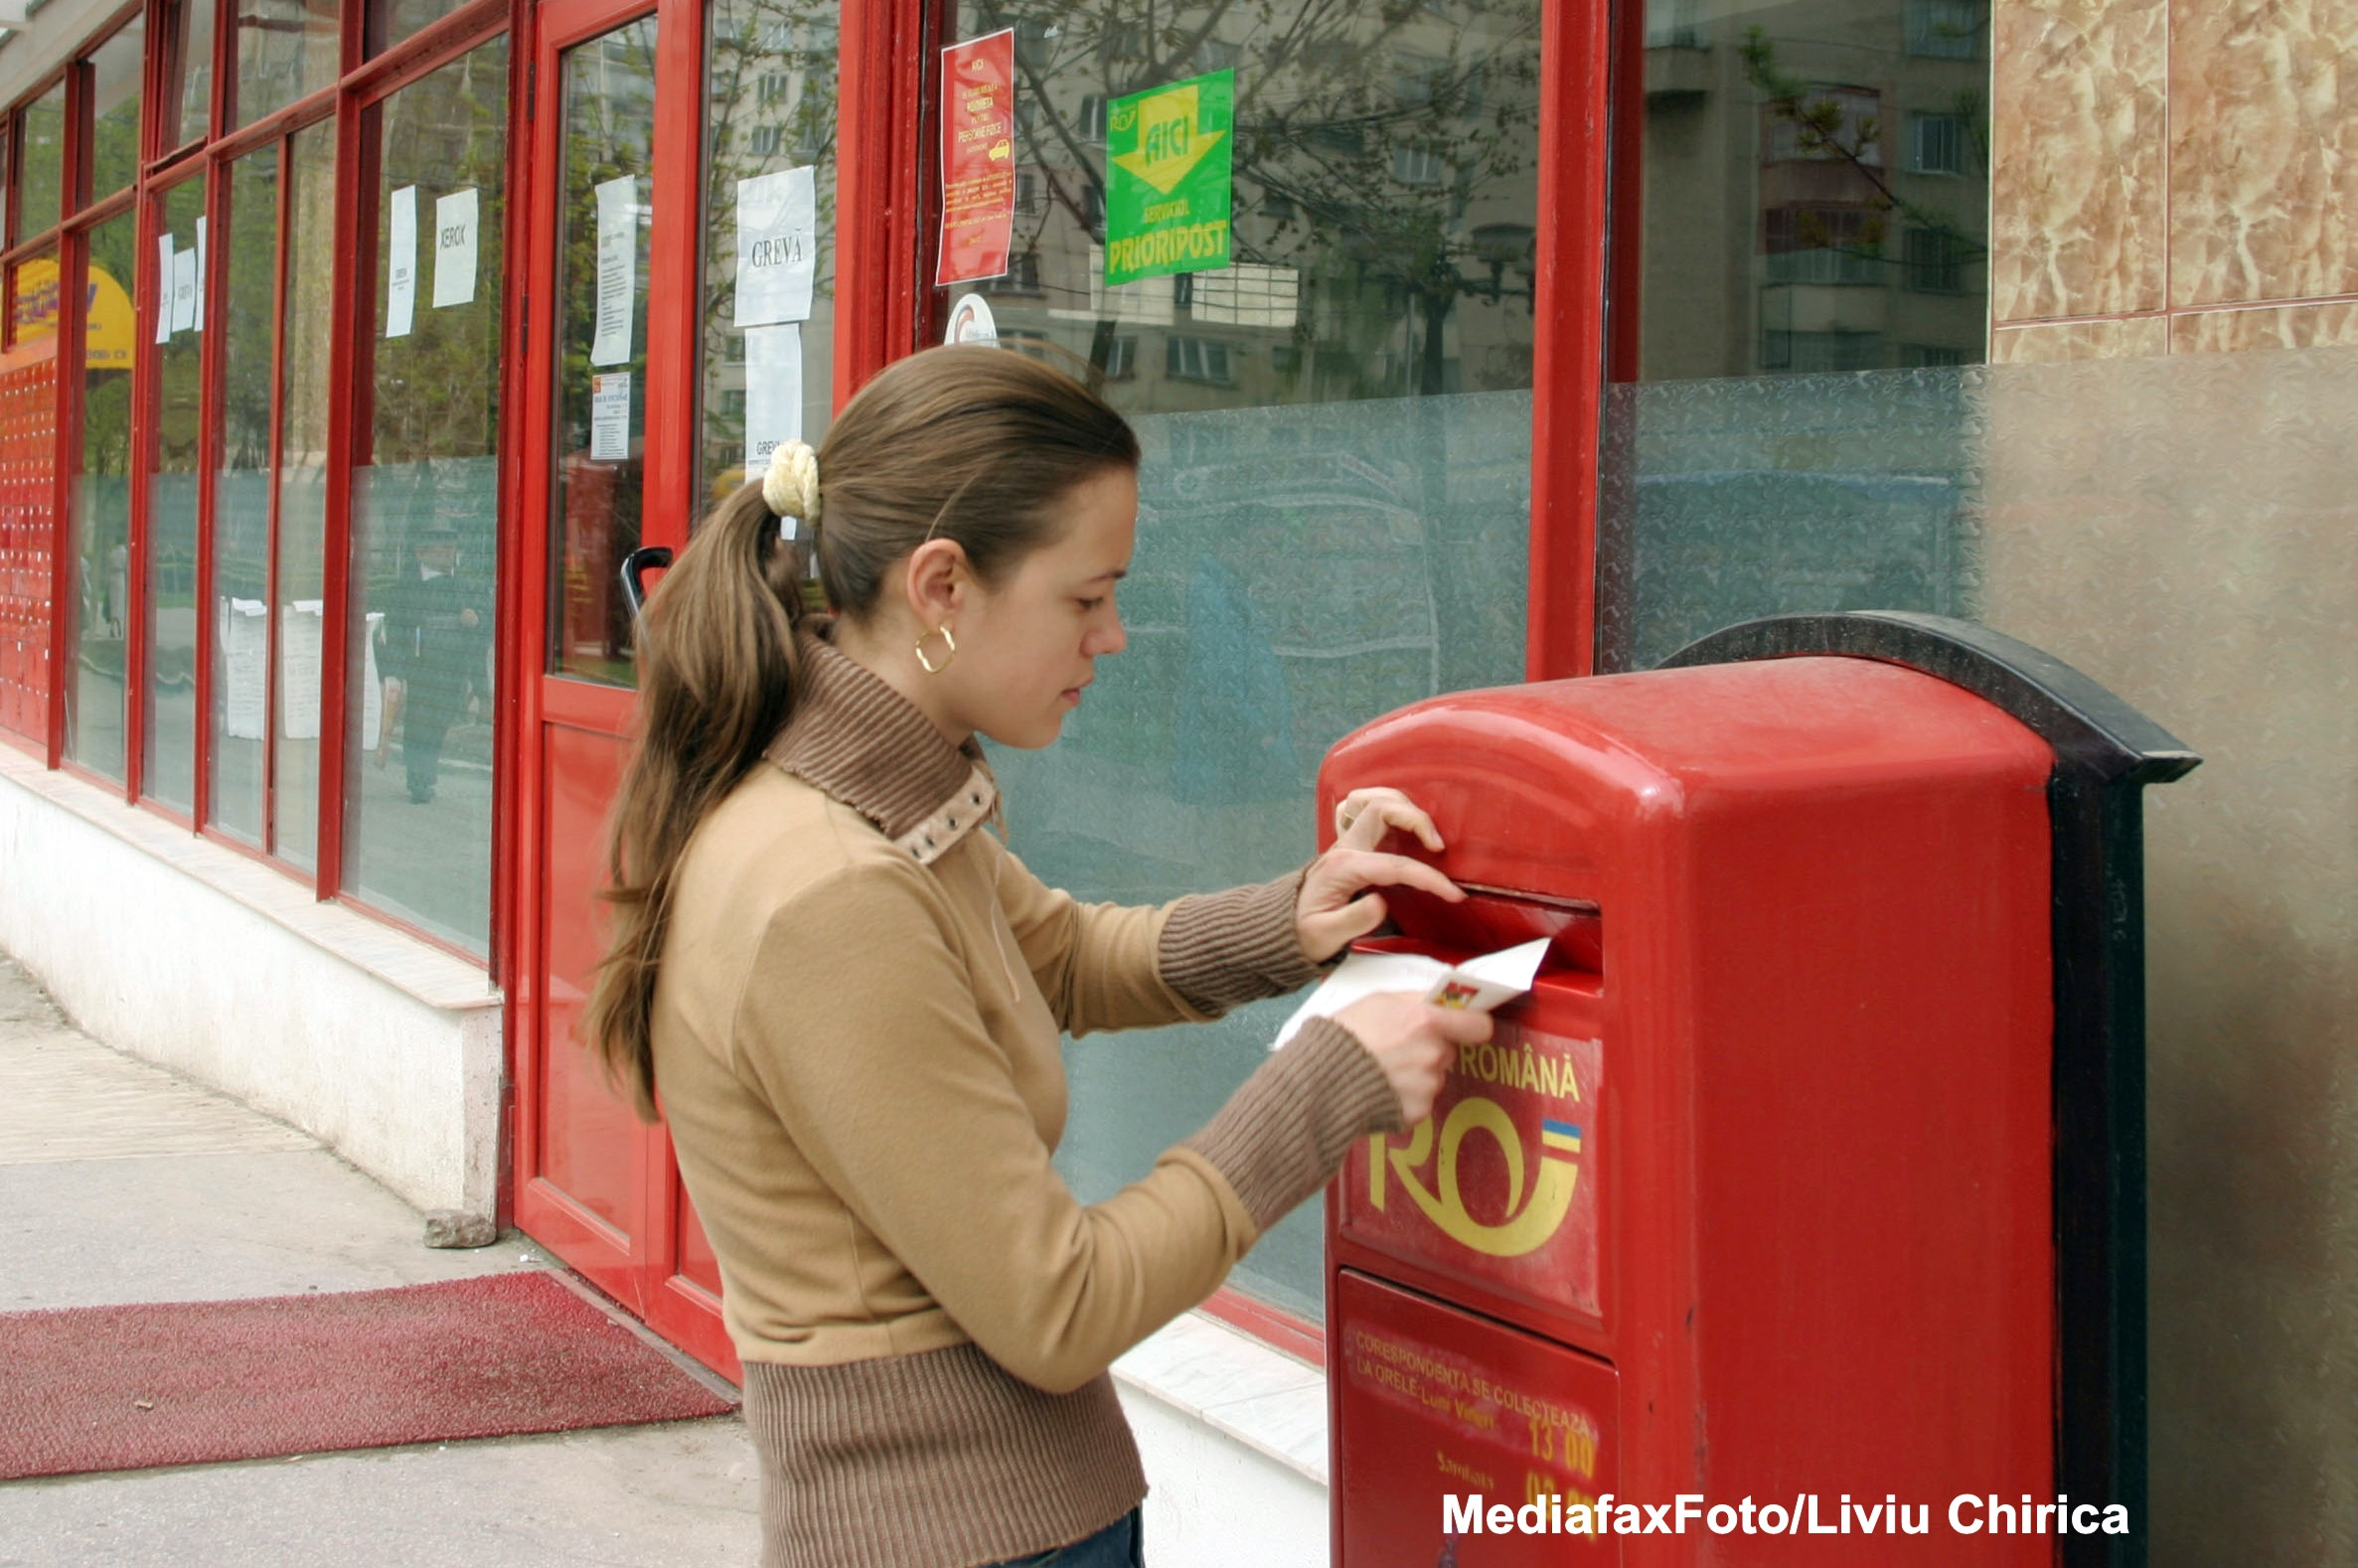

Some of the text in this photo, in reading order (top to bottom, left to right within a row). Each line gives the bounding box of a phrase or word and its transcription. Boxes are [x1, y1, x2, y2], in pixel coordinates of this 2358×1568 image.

[1145, 116, 1189, 168] AICI
[439, 224, 466, 249] XEROX
[751, 228, 802, 267] GREVĂ
[1109, 220, 1227, 273] PRIORIPOST
[1459, 1043, 1581, 1102] ROMÂNĂ
[1473, 1377, 1492, 1401] SE
[1357, 1356, 1372, 1377] LA
[1529, 1416, 1553, 1461] 13
[1565, 1429, 1595, 1478] 00
